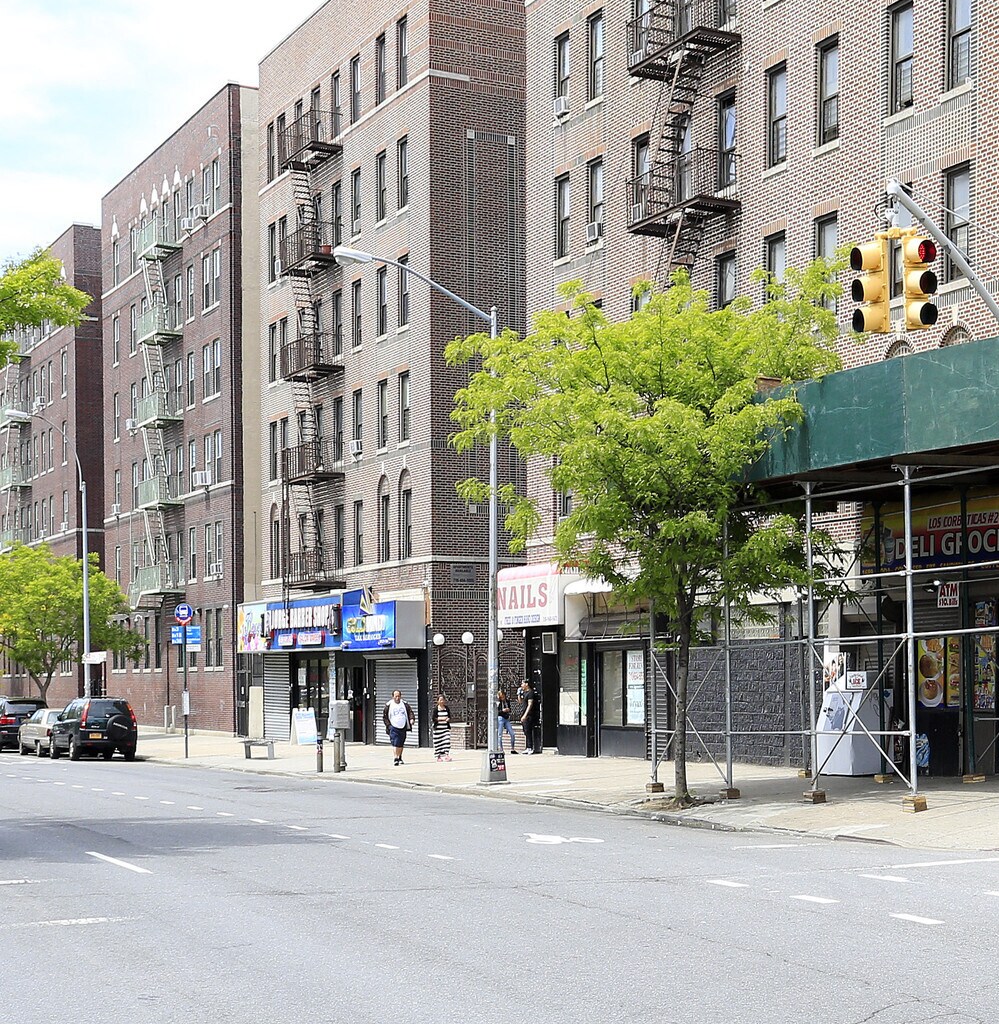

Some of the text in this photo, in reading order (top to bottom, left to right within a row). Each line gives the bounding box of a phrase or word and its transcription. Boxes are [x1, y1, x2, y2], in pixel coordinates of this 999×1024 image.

[928, 512, 999, 529] LOS CORBTICAS #2
[895, 534, 934, 560] DELI
[497, 582, 548, 611] NAILS
[940, 583, 958, 597] ATM
